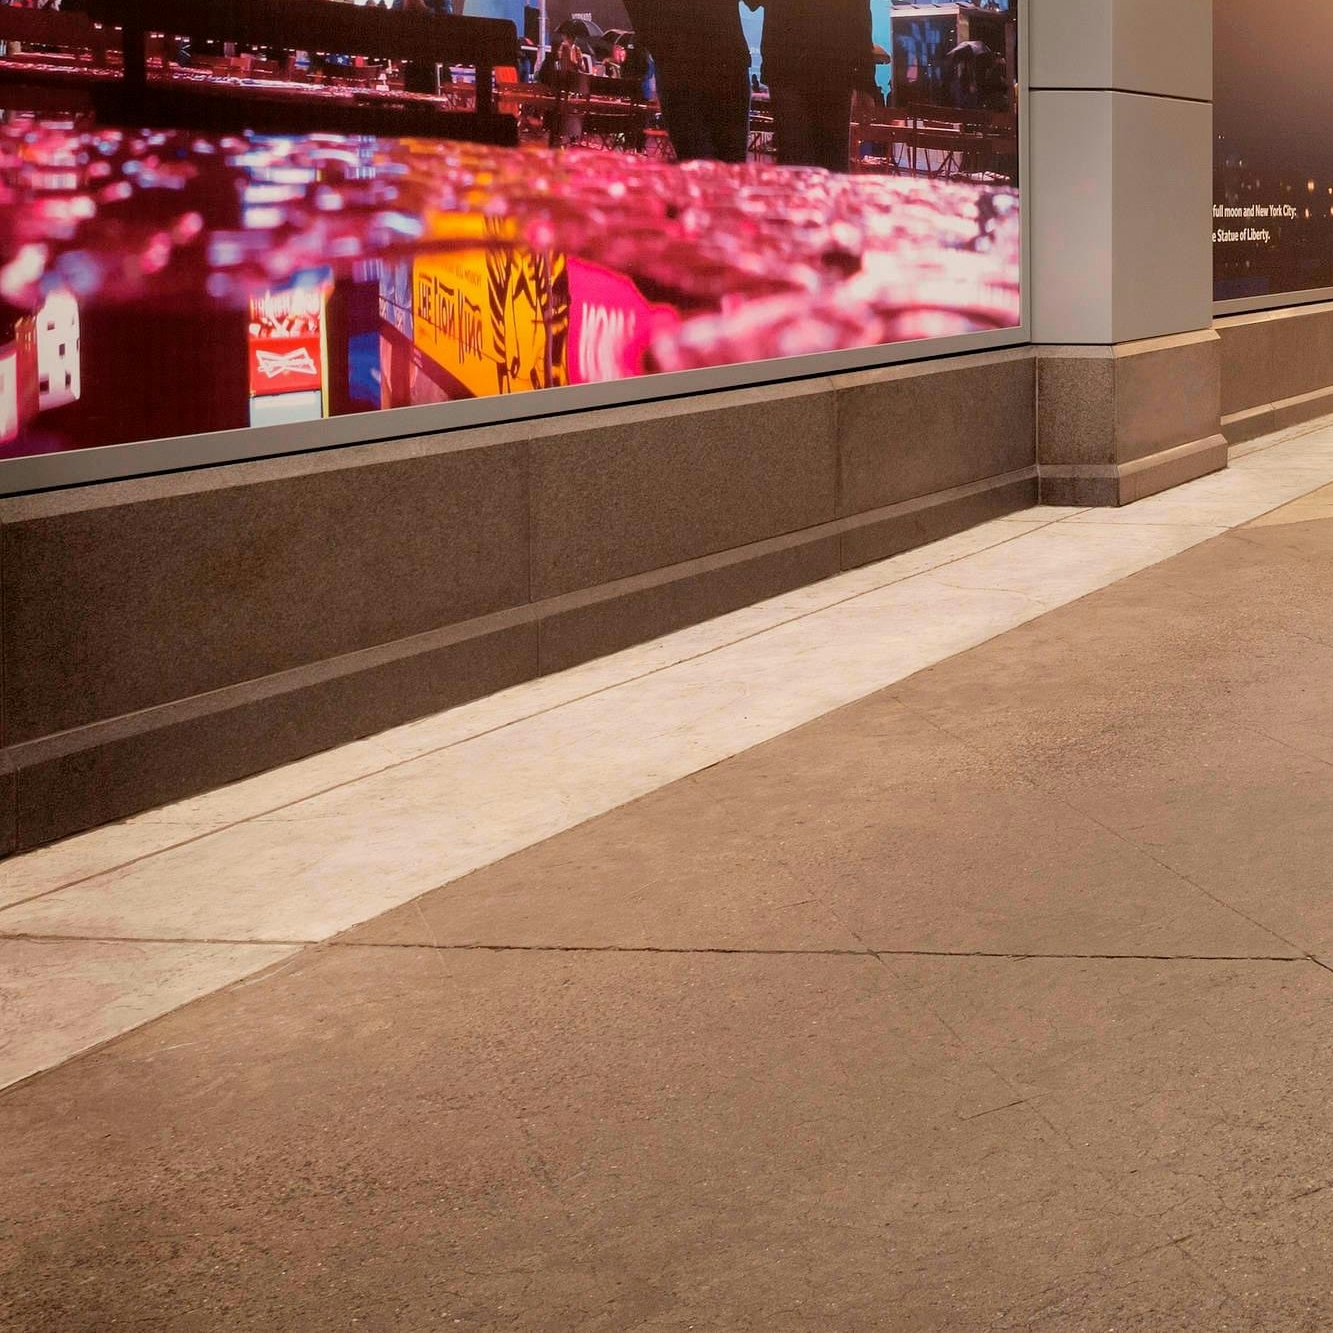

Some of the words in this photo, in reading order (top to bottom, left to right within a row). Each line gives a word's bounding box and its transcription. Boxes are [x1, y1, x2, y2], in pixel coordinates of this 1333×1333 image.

[1212, 204, 1224, 218] full
[1224, 207, 1242, 217] moon
[1243, 204, 1255, 217] and
[1255, 204, 1269, 217] New
[1269, 204, 1283, 217] York
[1217, 228, 1239, 243] Statue
[1240, 228, 1247, 241] of
[1247, 228, 1271, 243] Liberty.
